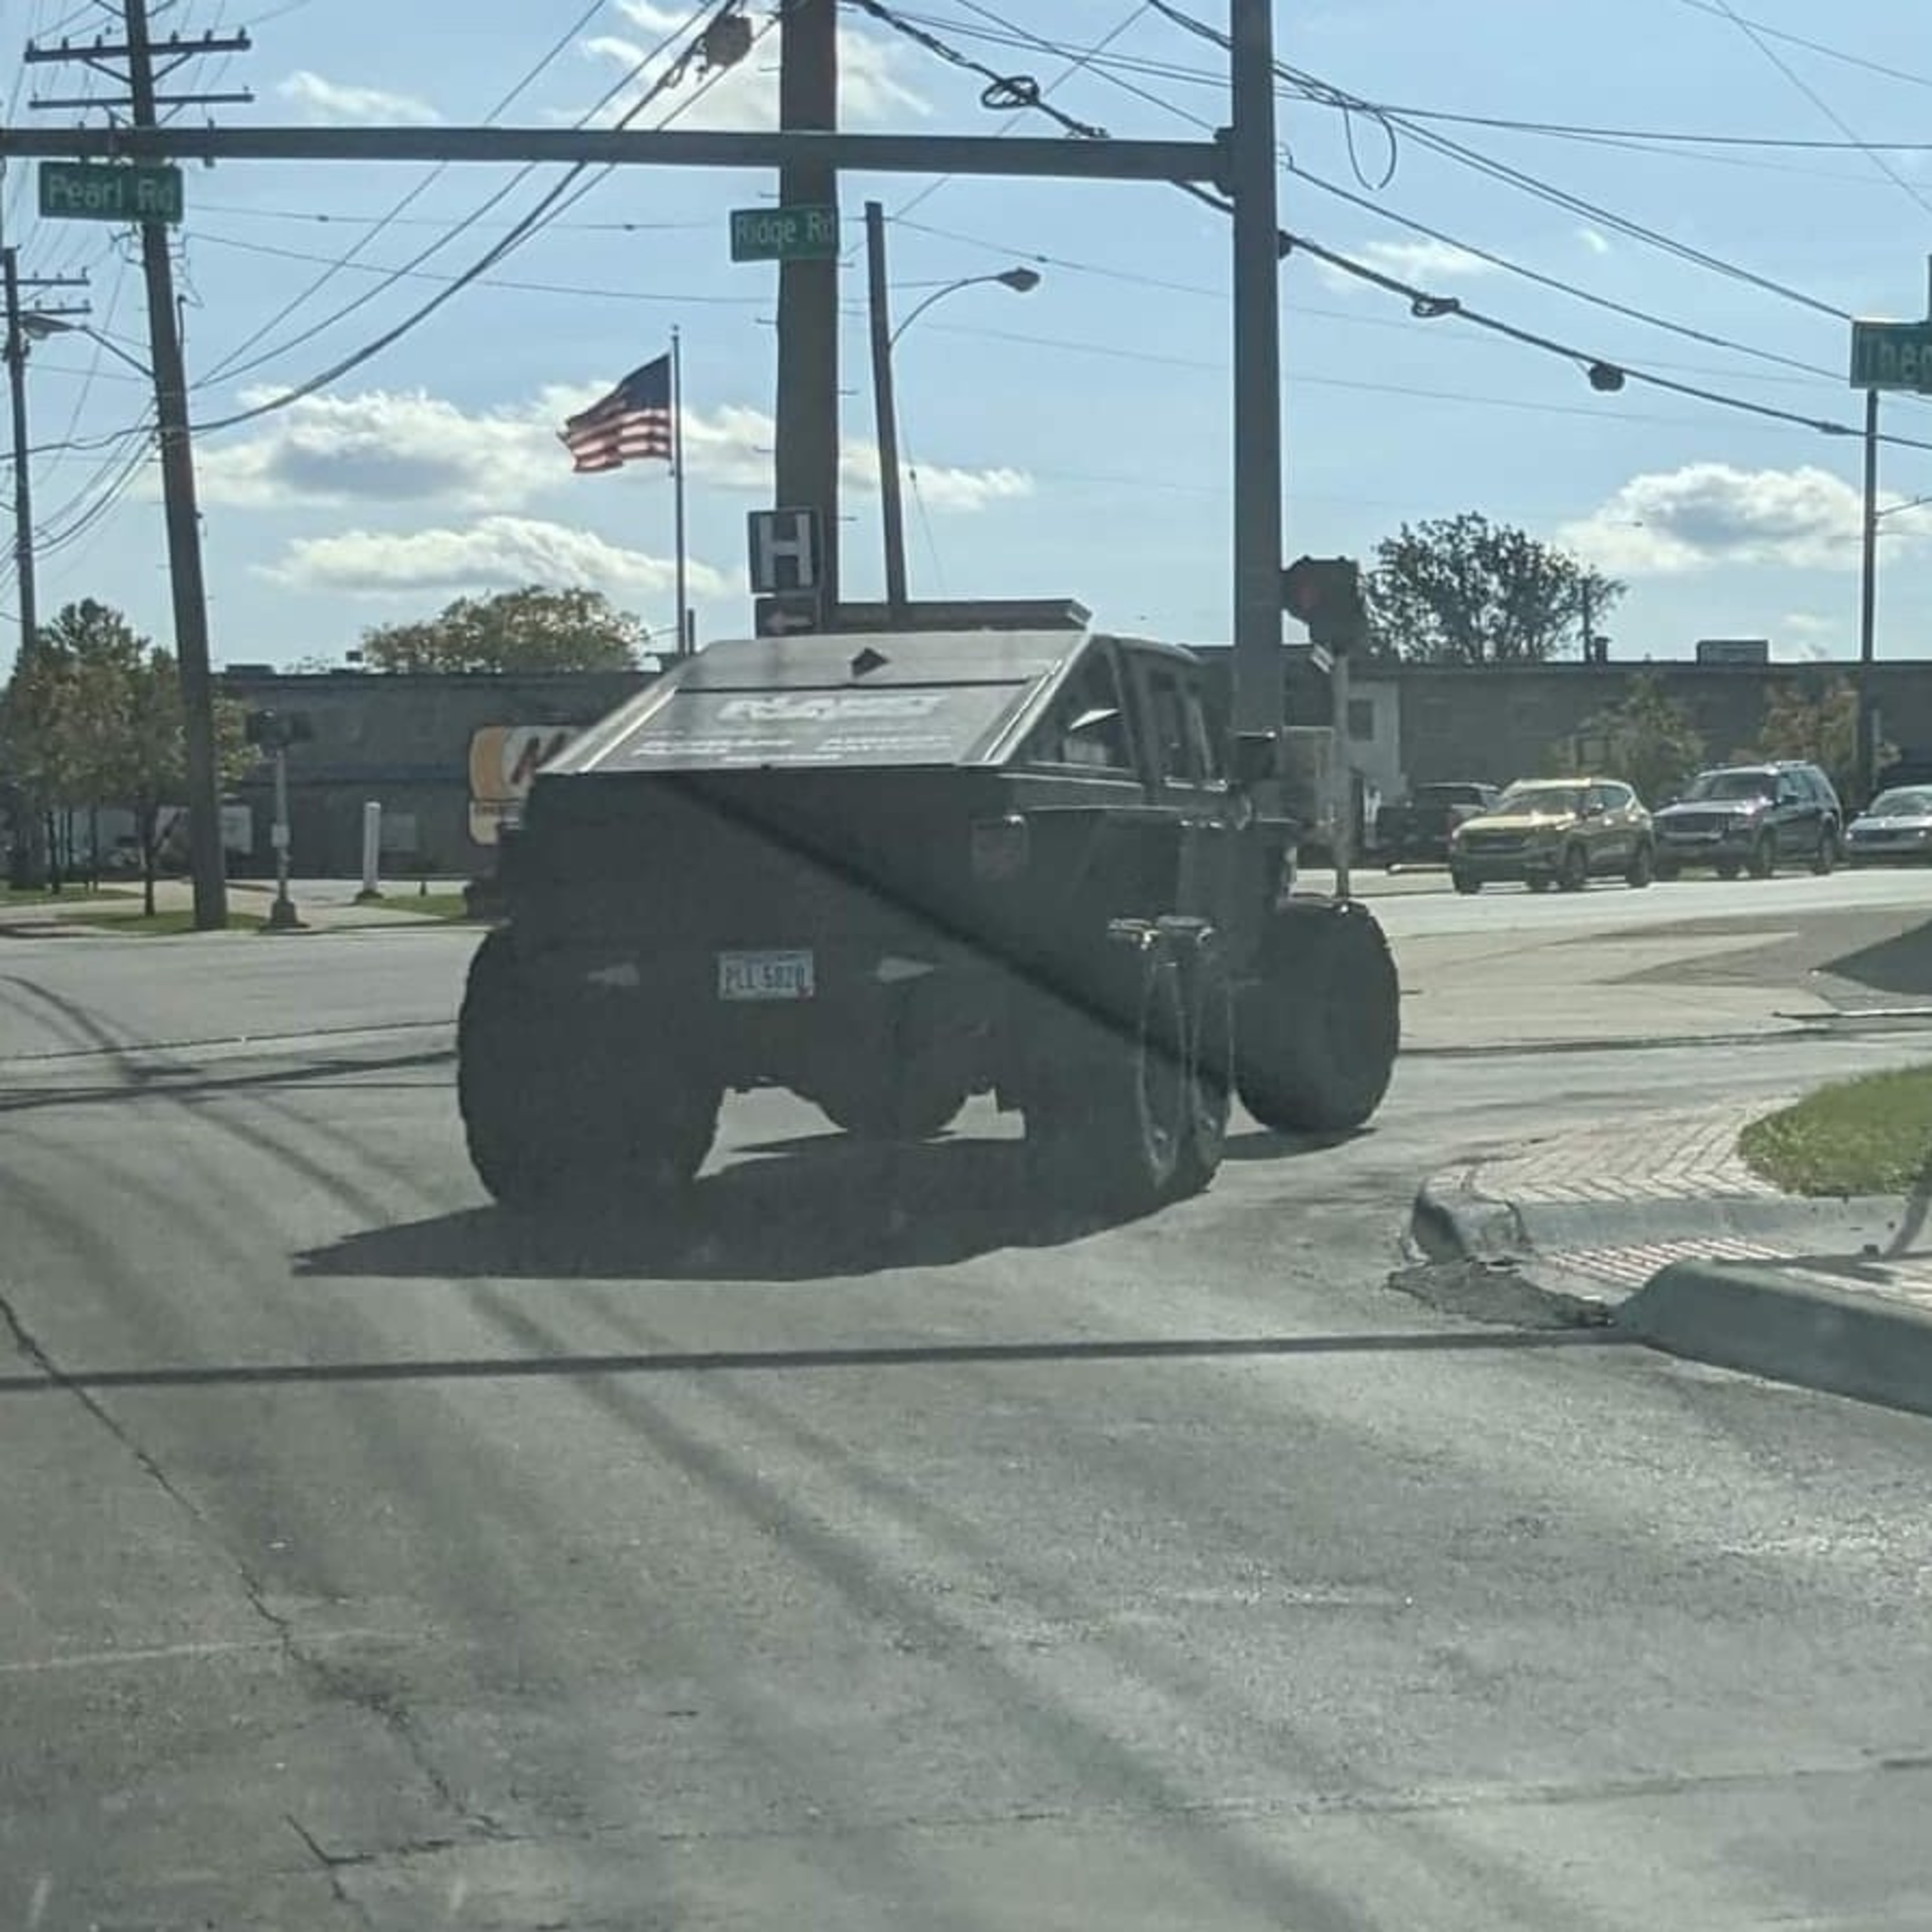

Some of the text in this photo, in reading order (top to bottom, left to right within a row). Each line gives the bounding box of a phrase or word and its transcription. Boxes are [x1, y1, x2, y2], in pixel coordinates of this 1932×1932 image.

[48, 173, 174, 211] Pearl Rd
[734, 211, 835, 252] Ridge Rd
[758, 513, 814, 587] H
